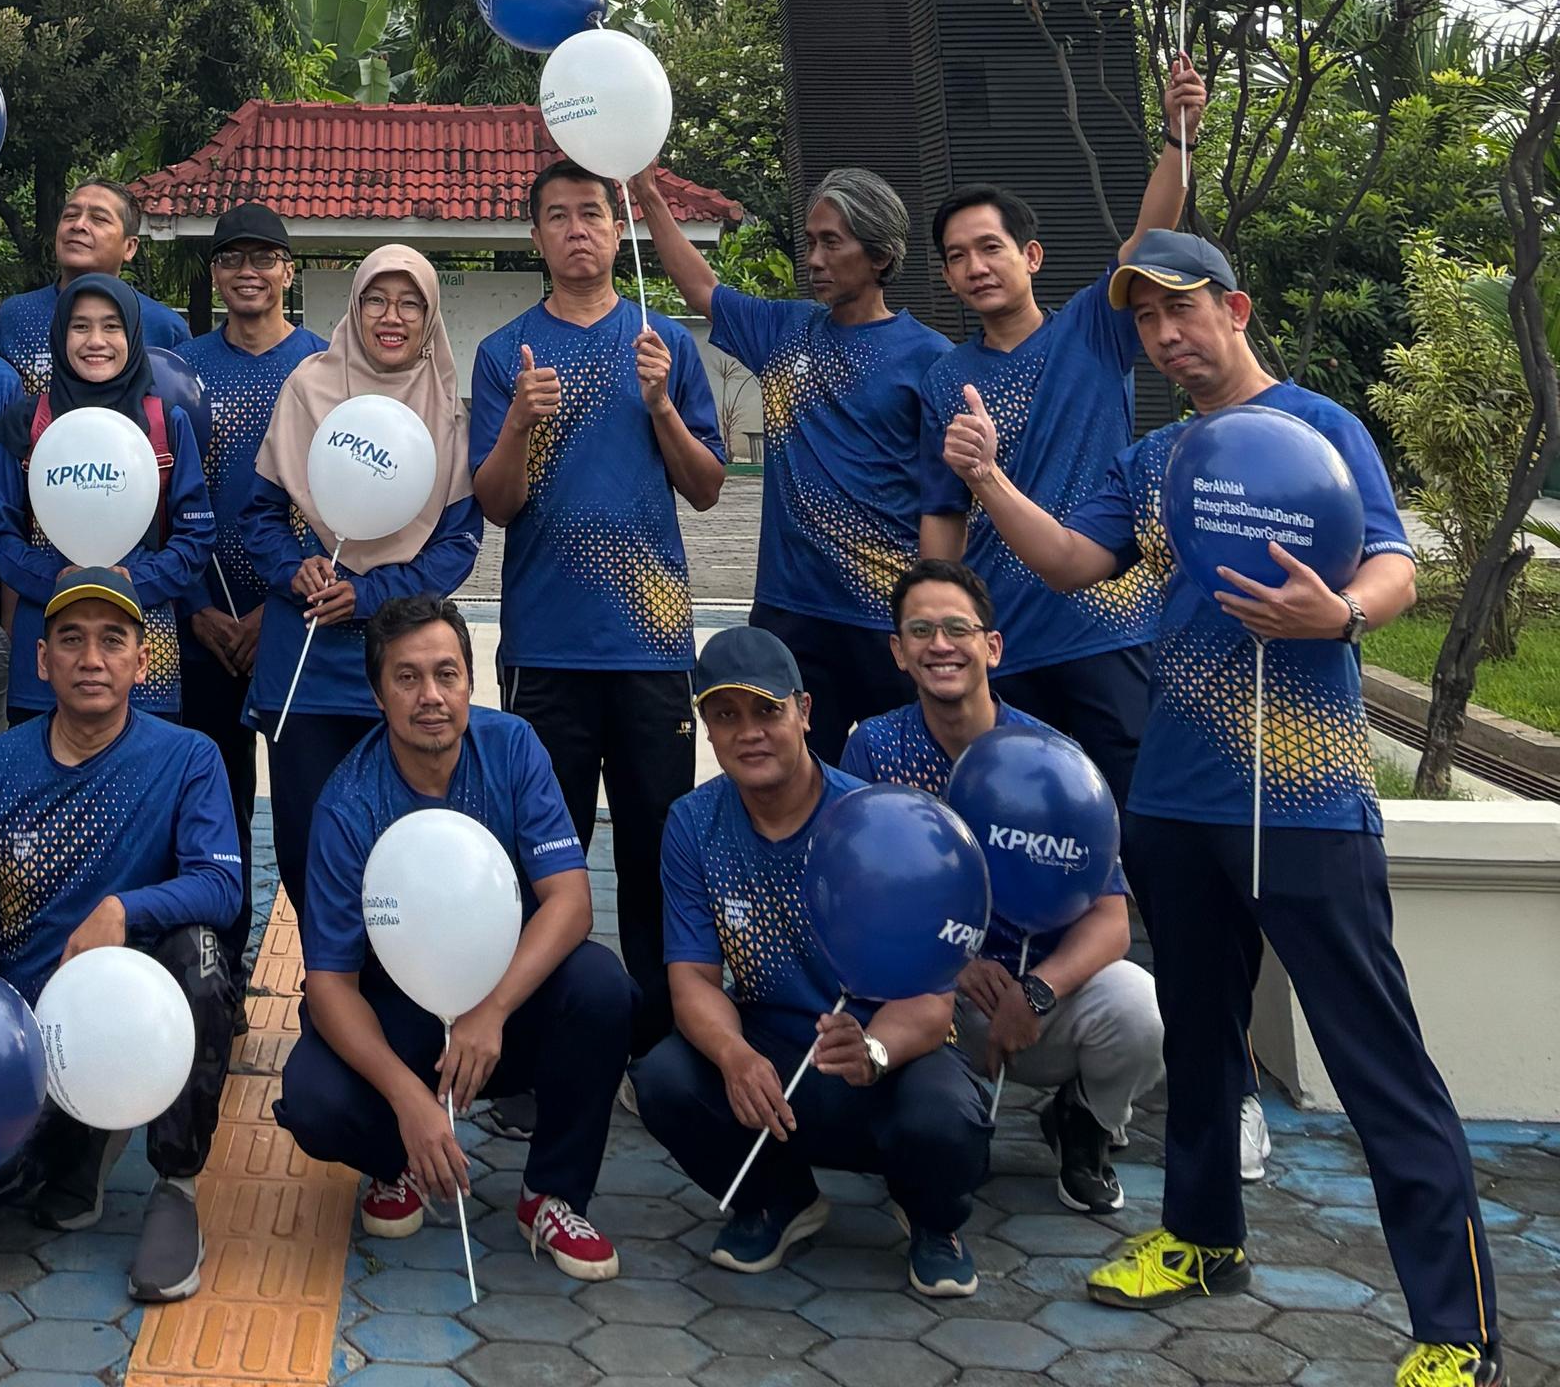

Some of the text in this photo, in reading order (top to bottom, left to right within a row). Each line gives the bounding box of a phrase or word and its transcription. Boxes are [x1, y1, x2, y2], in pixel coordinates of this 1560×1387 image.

[440, 275, 465, 286] Wall
[327, 431, 390, 469] KPKNL
[47, 463, 118, 487] KPKNL
[1193, 477, 1245, 496] #BerAkhlak
[988, 824, 1080, 859] KPKNL
